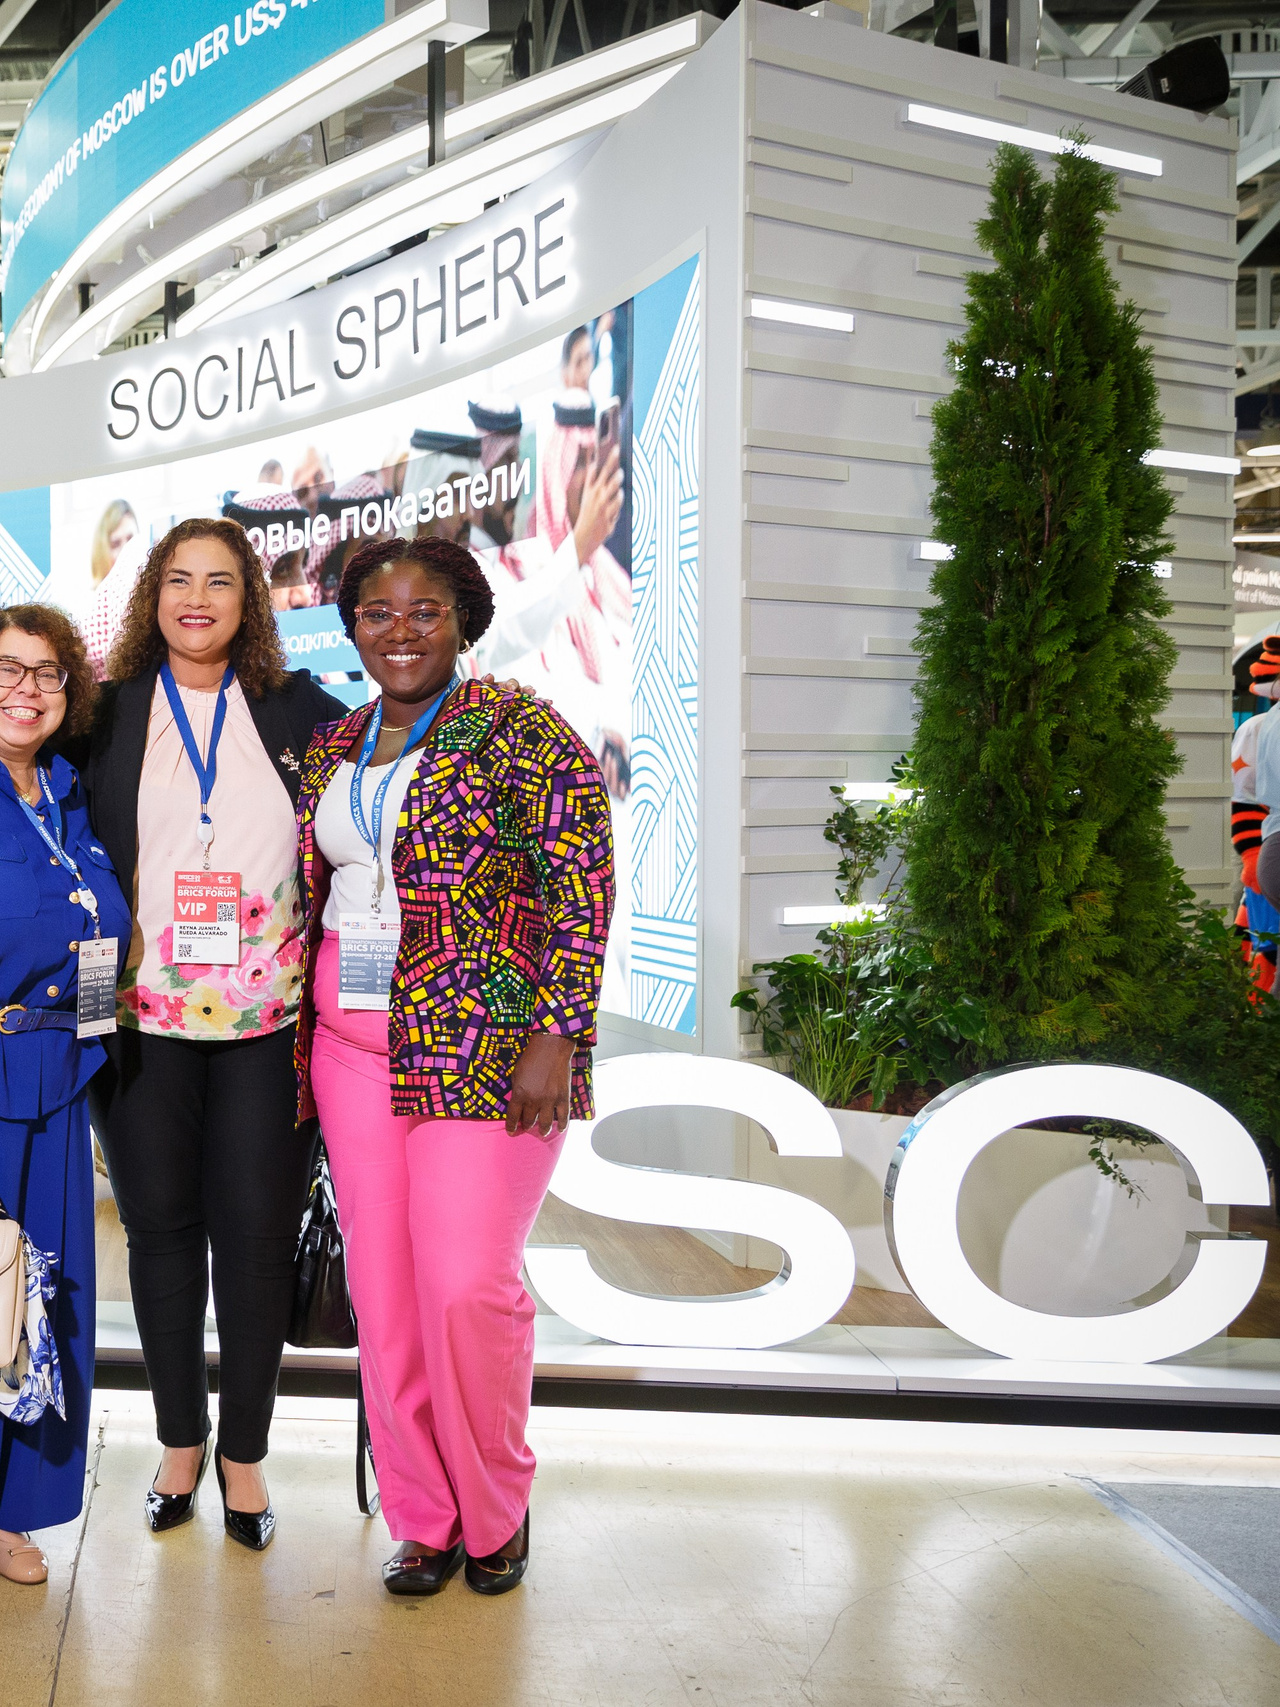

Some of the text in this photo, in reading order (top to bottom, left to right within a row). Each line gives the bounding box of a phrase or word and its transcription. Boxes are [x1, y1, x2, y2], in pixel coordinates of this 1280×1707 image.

[66, 138, 81, 176] OF
[82, 79, 147, 160] MOSCOW
[150, 65, 167, 104] IS
[170, 23, 229, 87] OVER
[234, 0, 287, 46] US$
[107, 197, 567, 440] SOCIAL SPHERE
[340, 457, 531, 542] показатели
[352, 780, 369, 840] IMBRICS FORUM
[177, 889, 237, 898] BRICS FORUM
[177, 902, 207, 916] VIP
[341, 944, 368, 952] BRICS
[80, 969, 115, 981] BRICS FORUM
